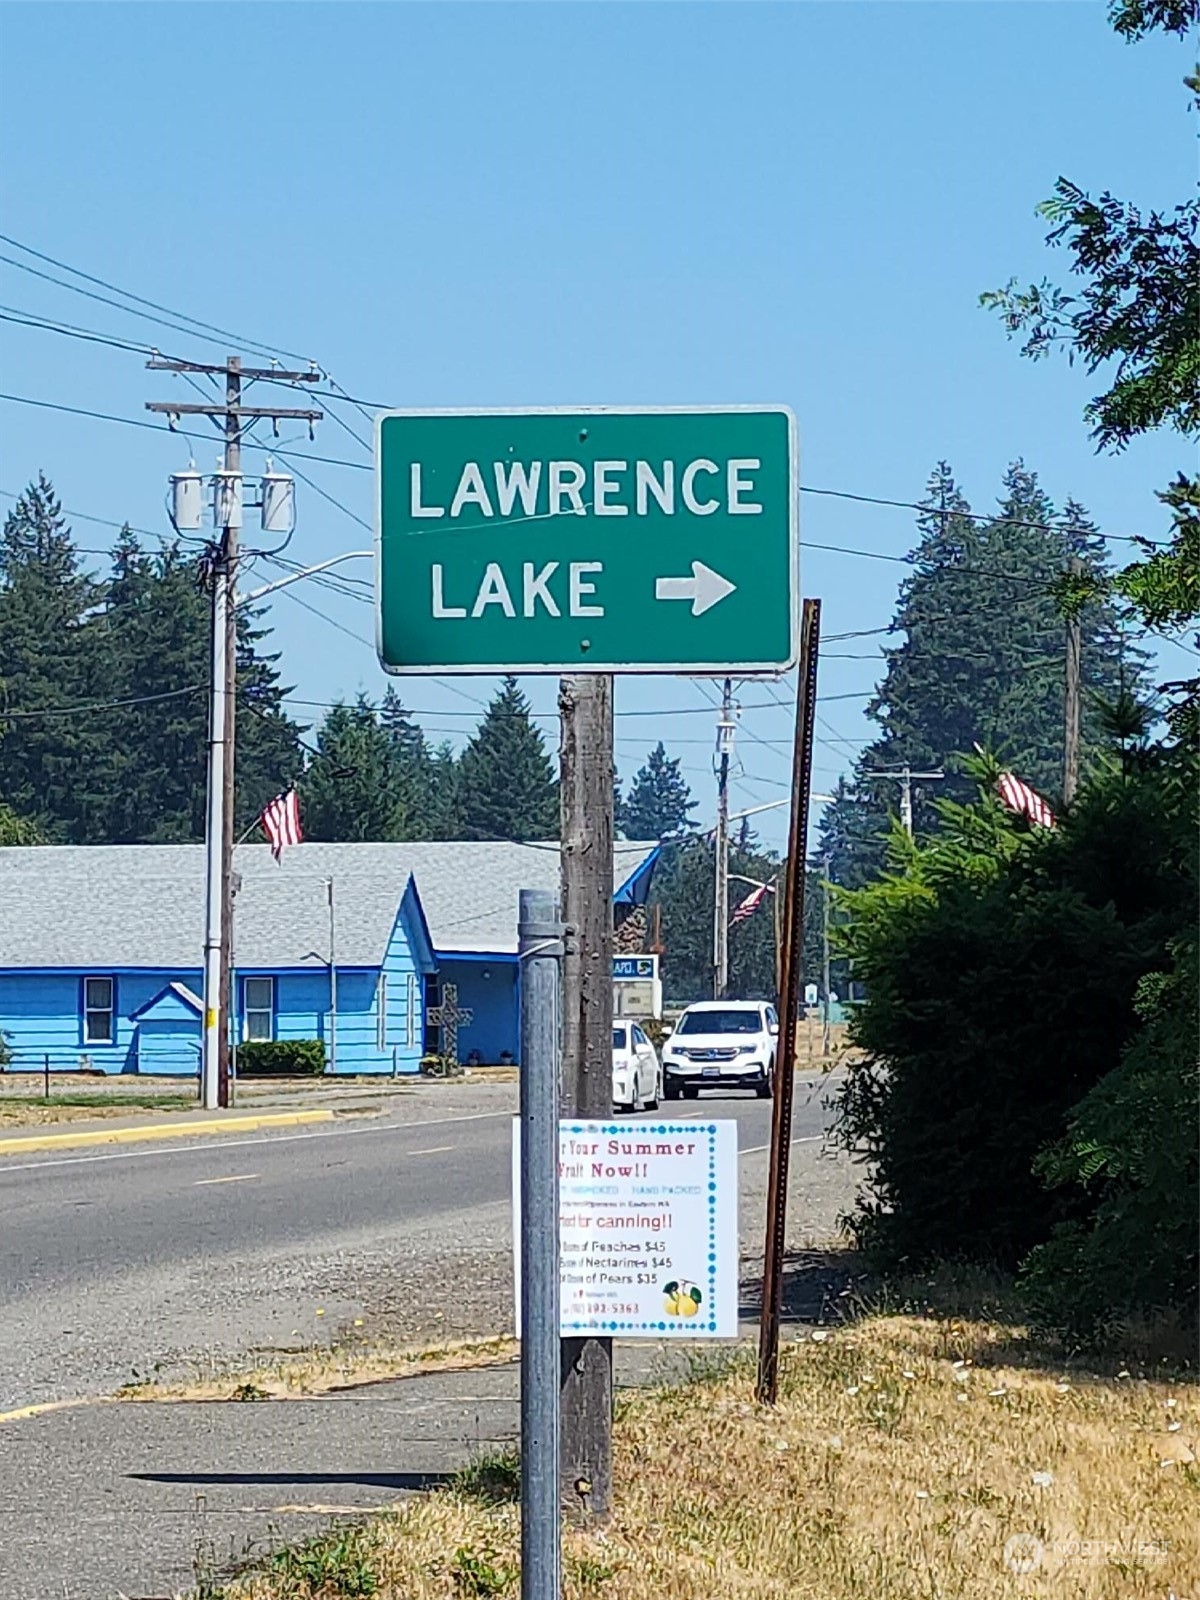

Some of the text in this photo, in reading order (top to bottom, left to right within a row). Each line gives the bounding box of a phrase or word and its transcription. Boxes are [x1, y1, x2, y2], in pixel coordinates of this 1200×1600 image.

[410, 458, 763, 518] LAWRENCE
[432, 562, 604, 619] LAKE
[570, 1140, 599, 1155] Your
[608, 1140, 695, 1155] Summer
[591, 1163, 647, 1178] Now!!
[662, 1186, 701, 1194] PACKED
[597, 1213, 672, 1231] canning!!
[592, 1241, 641, 1252] Peaches
[586, 1257, 648, 1268] Nectarines
[652, 1257, 673, 1268] $45
[586, 1273, 596, 1284] of
[600, 1273, 633, 1284] Pears
[637, 1273, 657, 1284] $35
